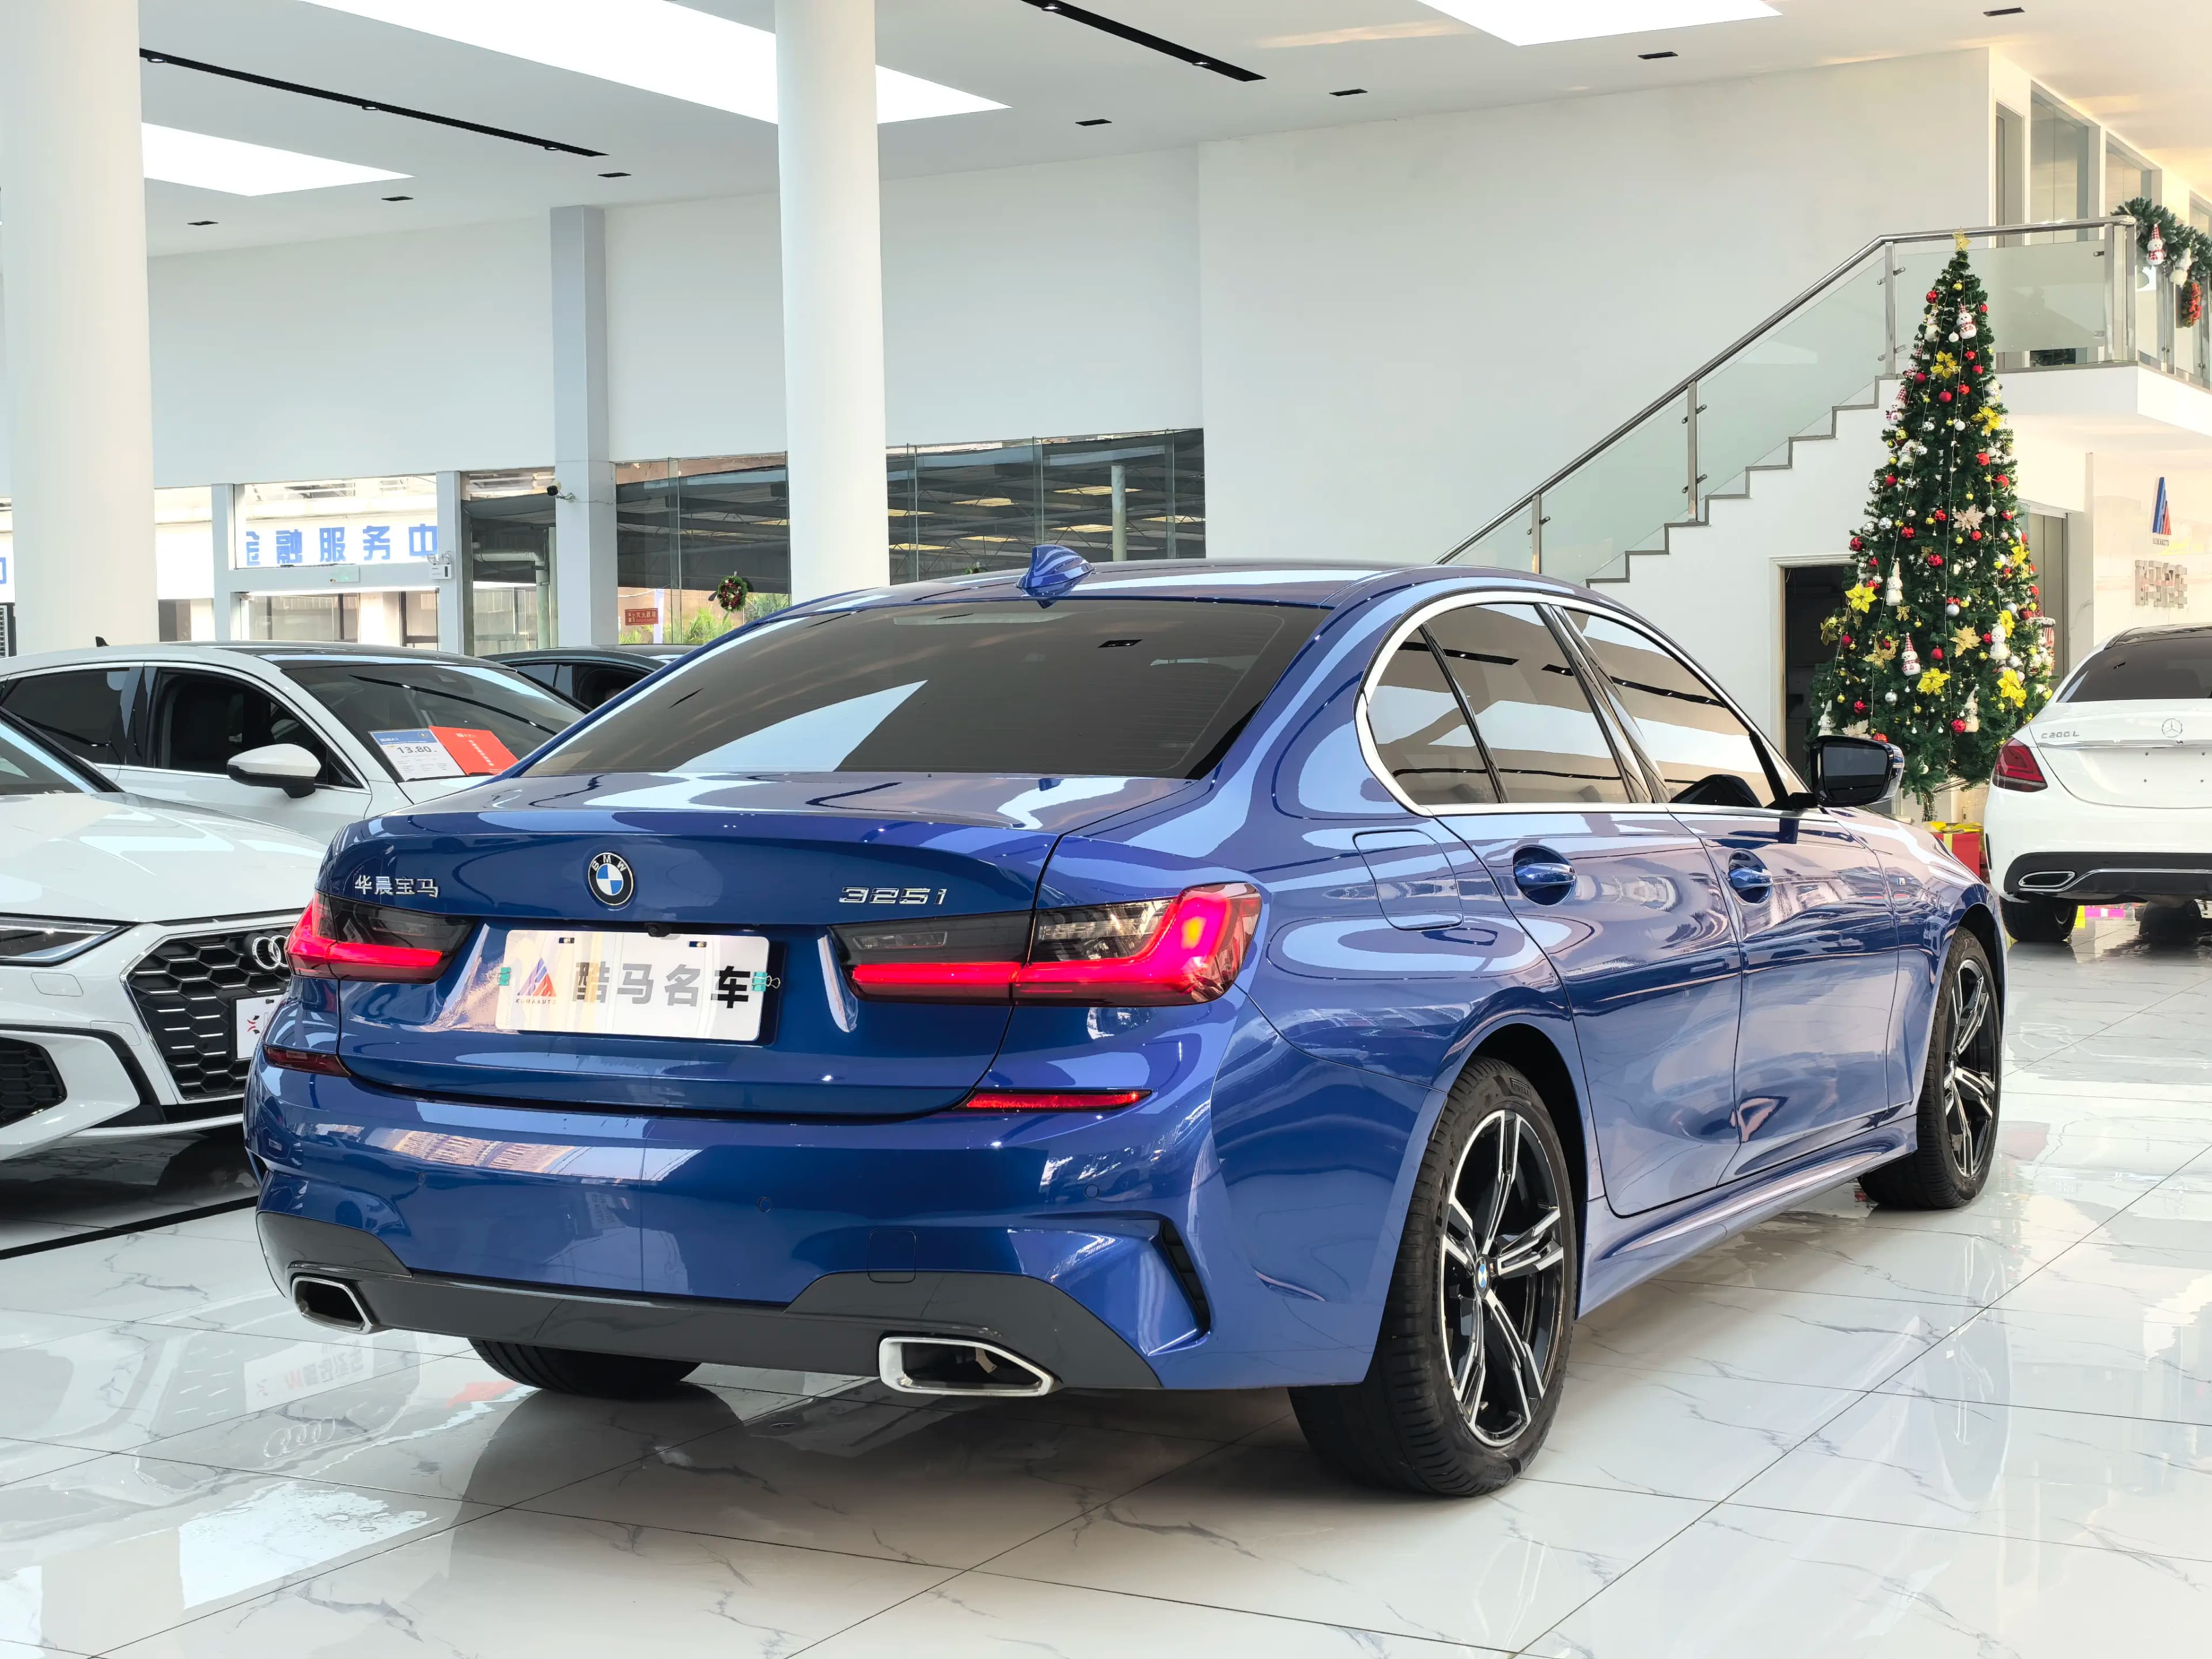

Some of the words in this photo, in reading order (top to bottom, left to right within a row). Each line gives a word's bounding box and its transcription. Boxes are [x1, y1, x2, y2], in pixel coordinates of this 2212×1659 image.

[592, 854, 627, 871] BMW
[354, 874, 438, 897] 华晨宝马
[572, 961, 751, 1008] 酷马名车
